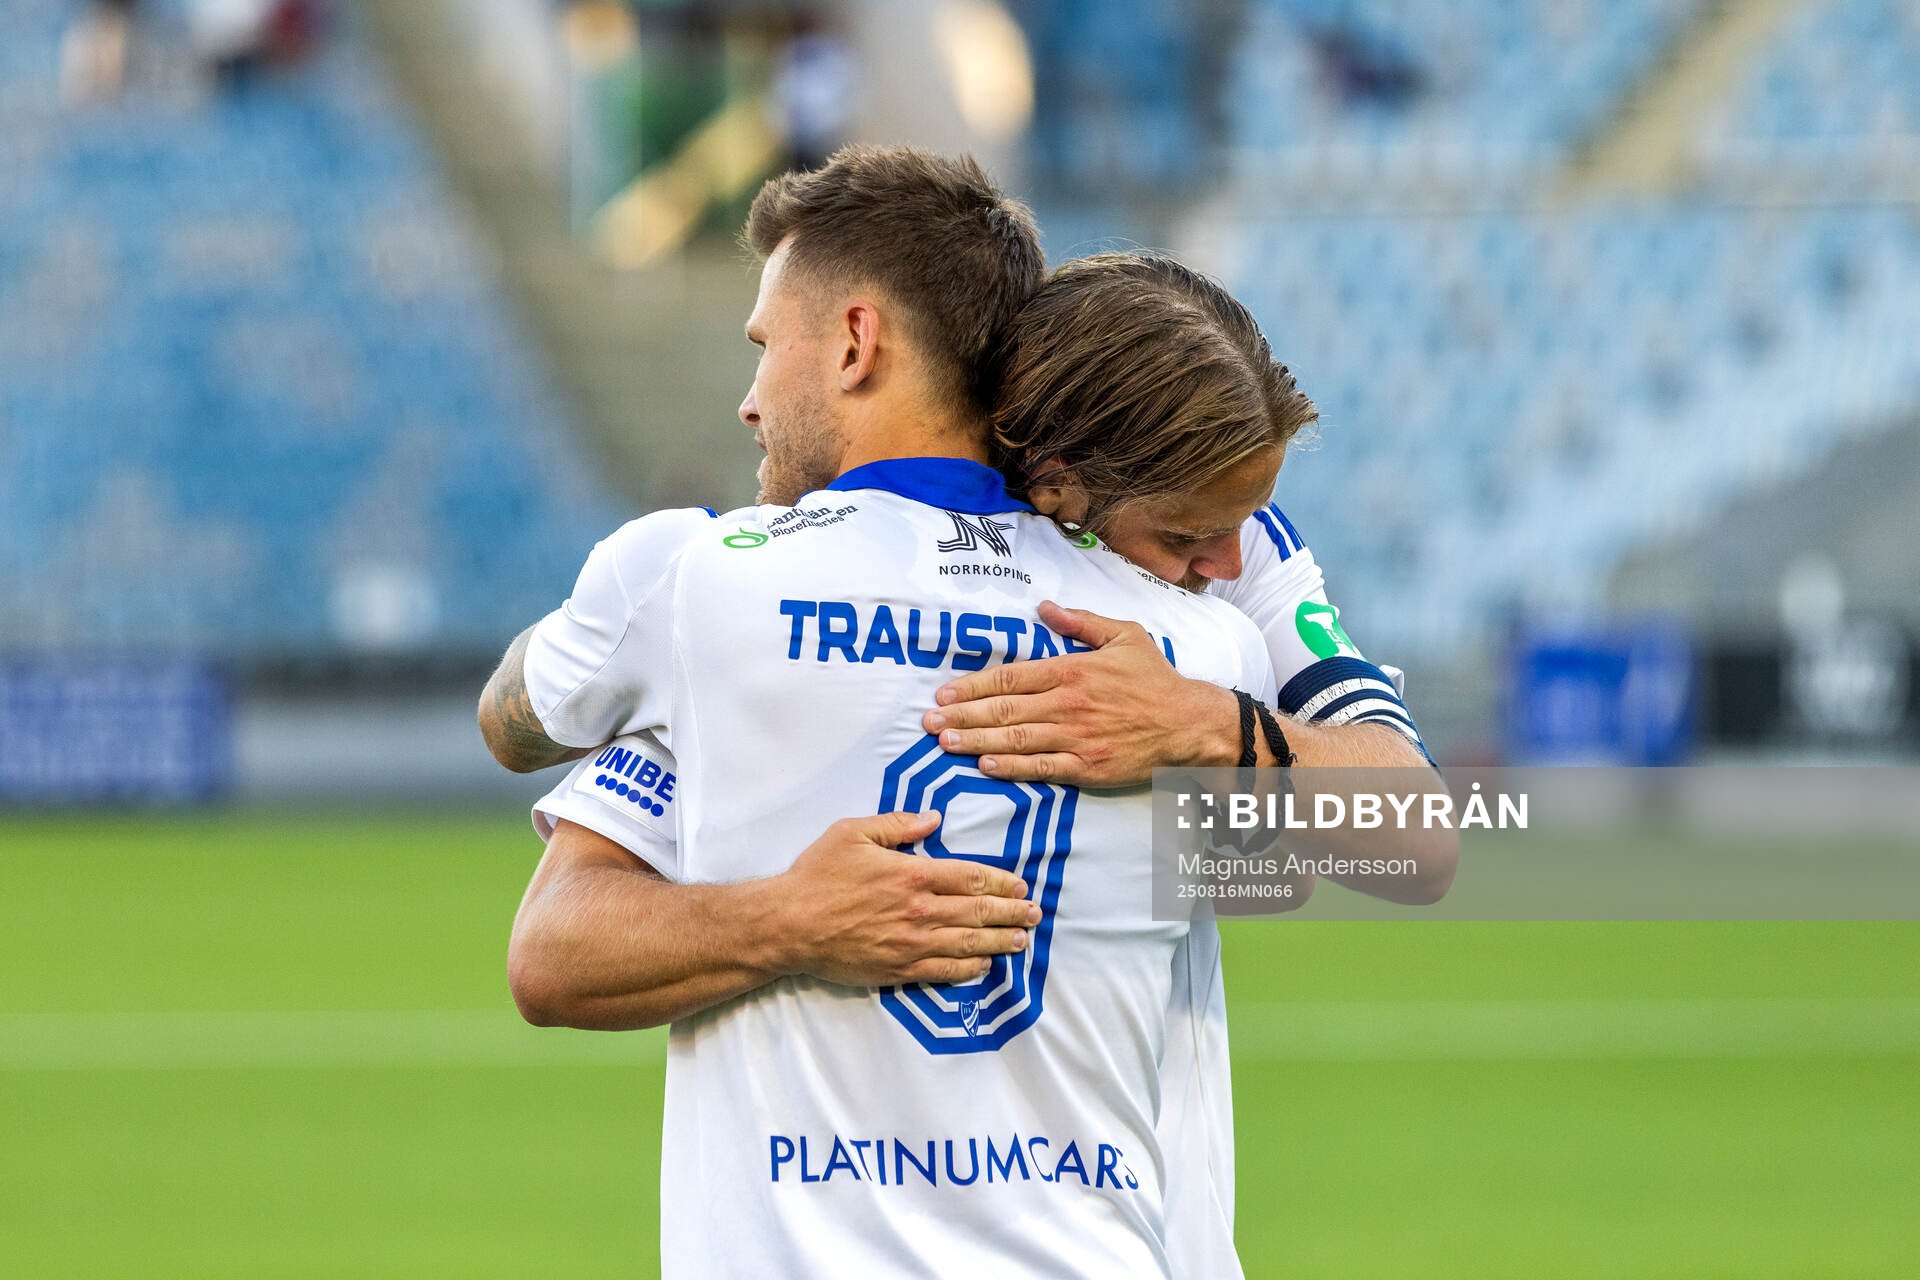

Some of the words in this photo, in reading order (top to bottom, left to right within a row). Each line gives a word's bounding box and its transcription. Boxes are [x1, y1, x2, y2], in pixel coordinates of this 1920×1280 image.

[939, 564, 1032, 584] NORRKÖPING
[779, 599, 1176, 670] TRAUSTA
[594, 746, 677, 803] UNIBE
[877, 734, 1080, 1055] 9
